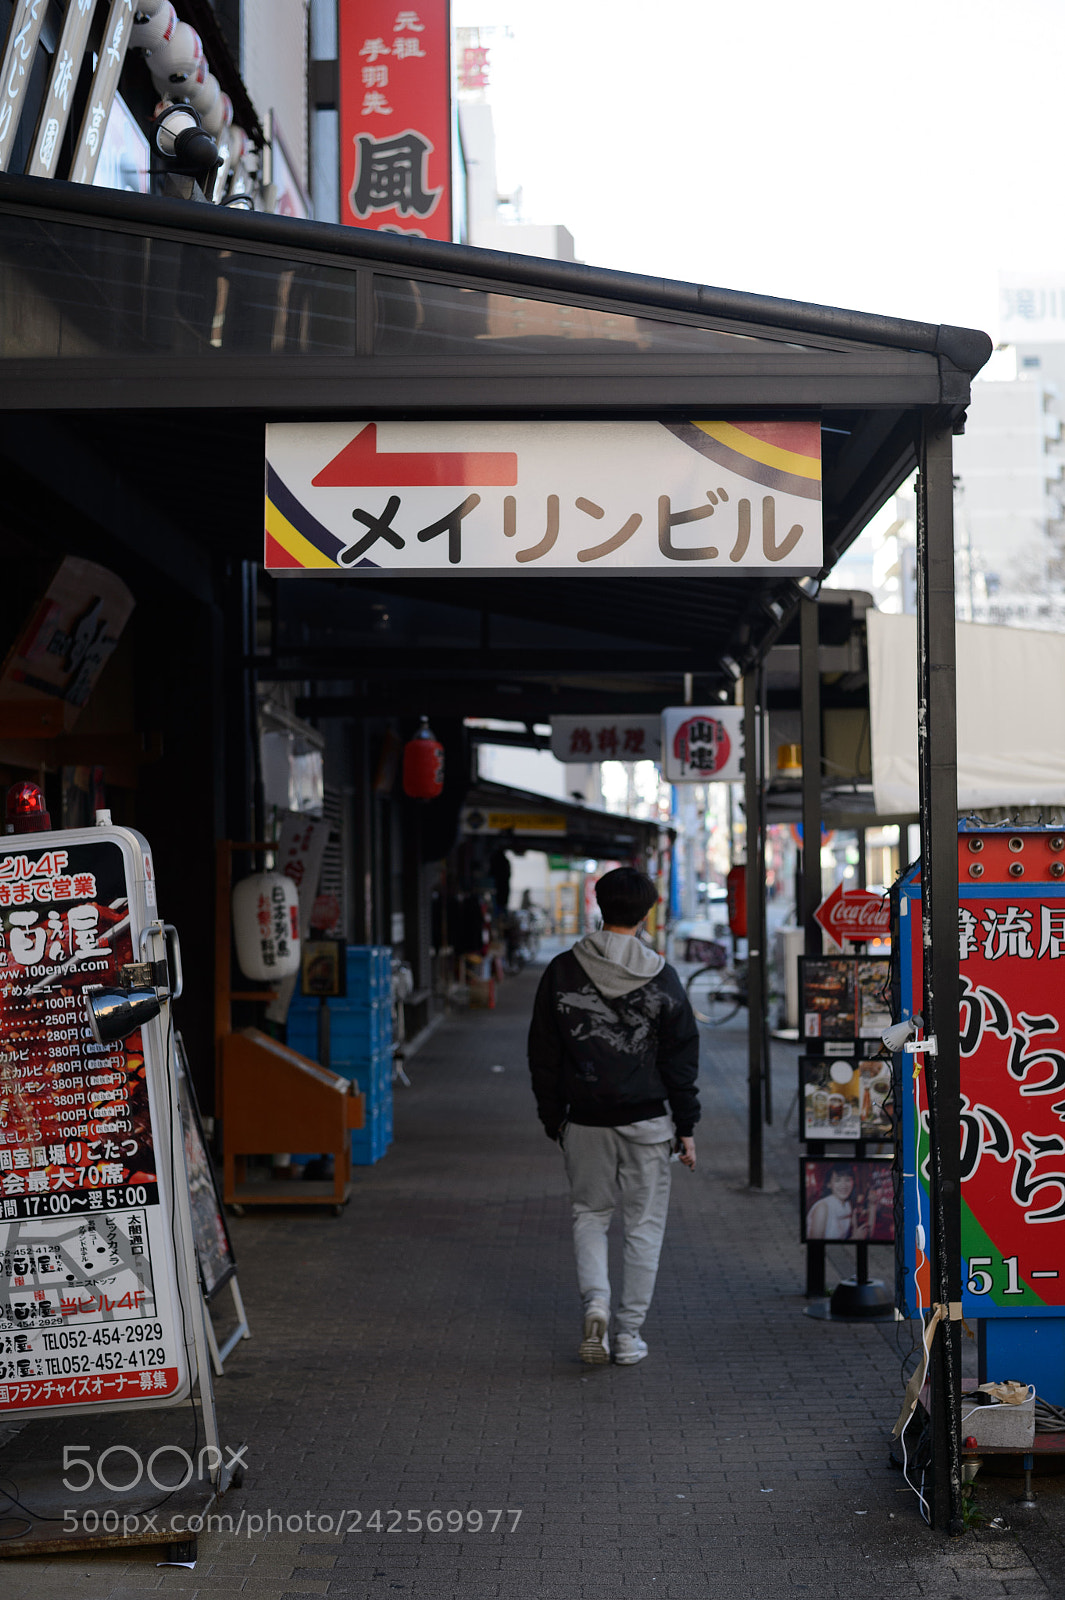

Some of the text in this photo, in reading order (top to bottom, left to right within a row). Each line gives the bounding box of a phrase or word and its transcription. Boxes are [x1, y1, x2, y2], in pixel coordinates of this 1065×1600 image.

[393, 11, 426, 59] 元祖
[358, 38, 393, 115] 手羽先
[349, 129, 443, 238] 風
[341, 487, 804, 564] メイリンビル
[0, 1080, 46, 1096] ホルモン
[0, 1163, 124, 1195] 会最大70席
[60, 1290, 146, 1316] 当ビル4F
